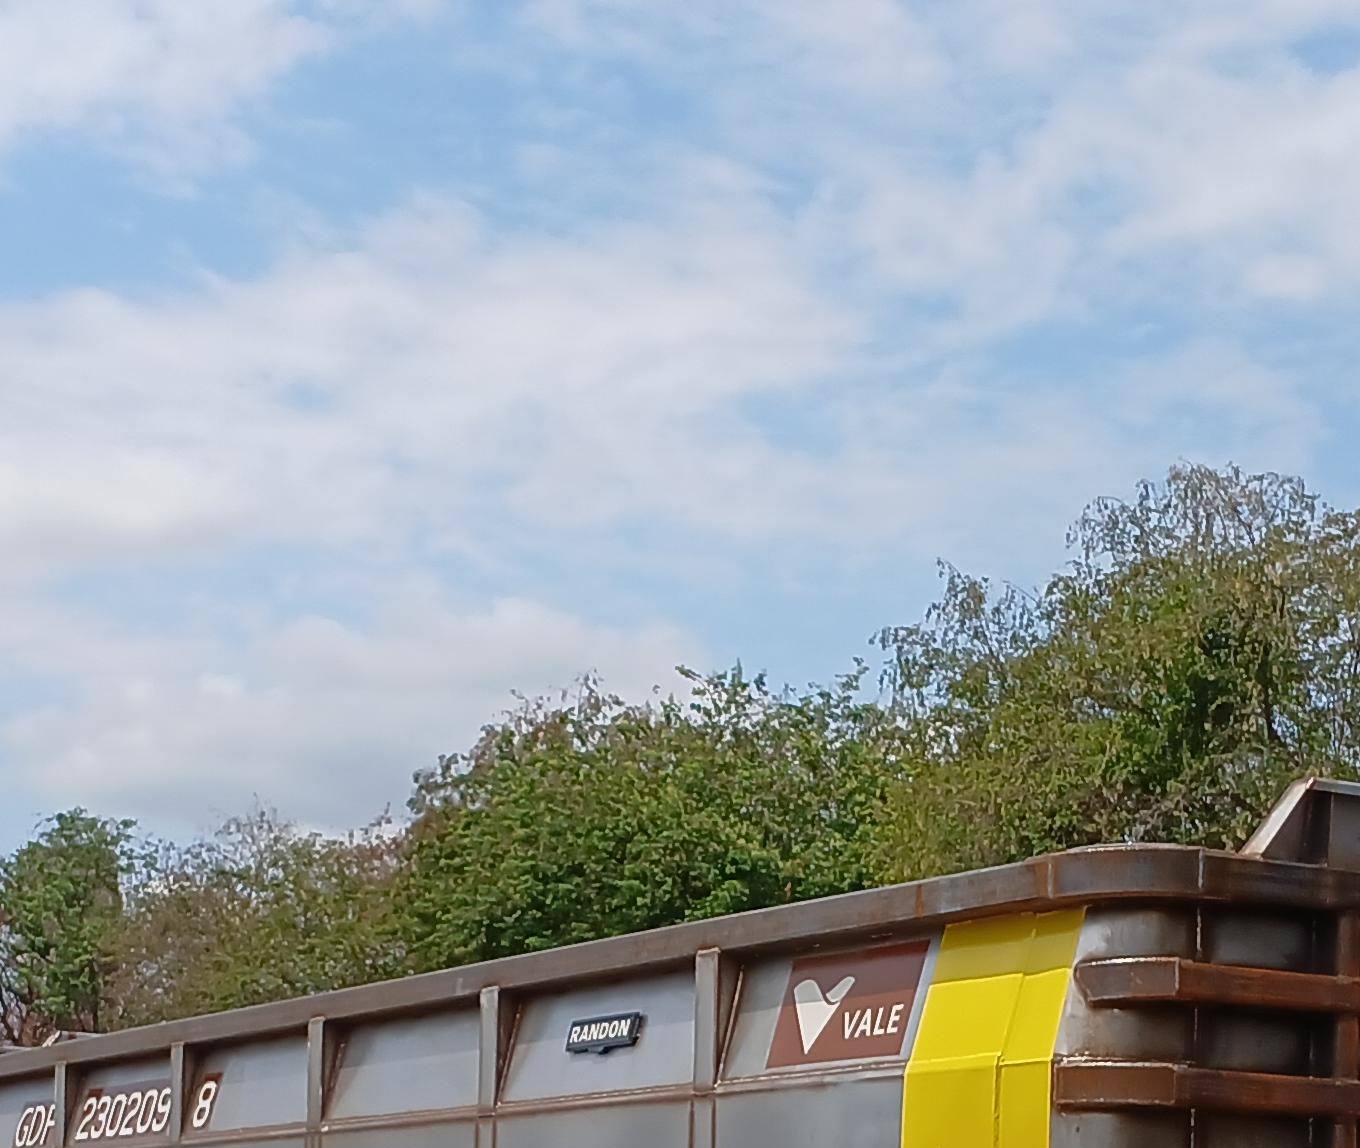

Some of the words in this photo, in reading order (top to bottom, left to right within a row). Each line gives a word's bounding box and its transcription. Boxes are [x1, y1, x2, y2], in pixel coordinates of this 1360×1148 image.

[569, 1018, 631, 1044] RANDON
[842, 1003, 905, 1040] VALE
[74, 1086, 172, 1140] 230209
[192, 1080, 218, 1128] 8
